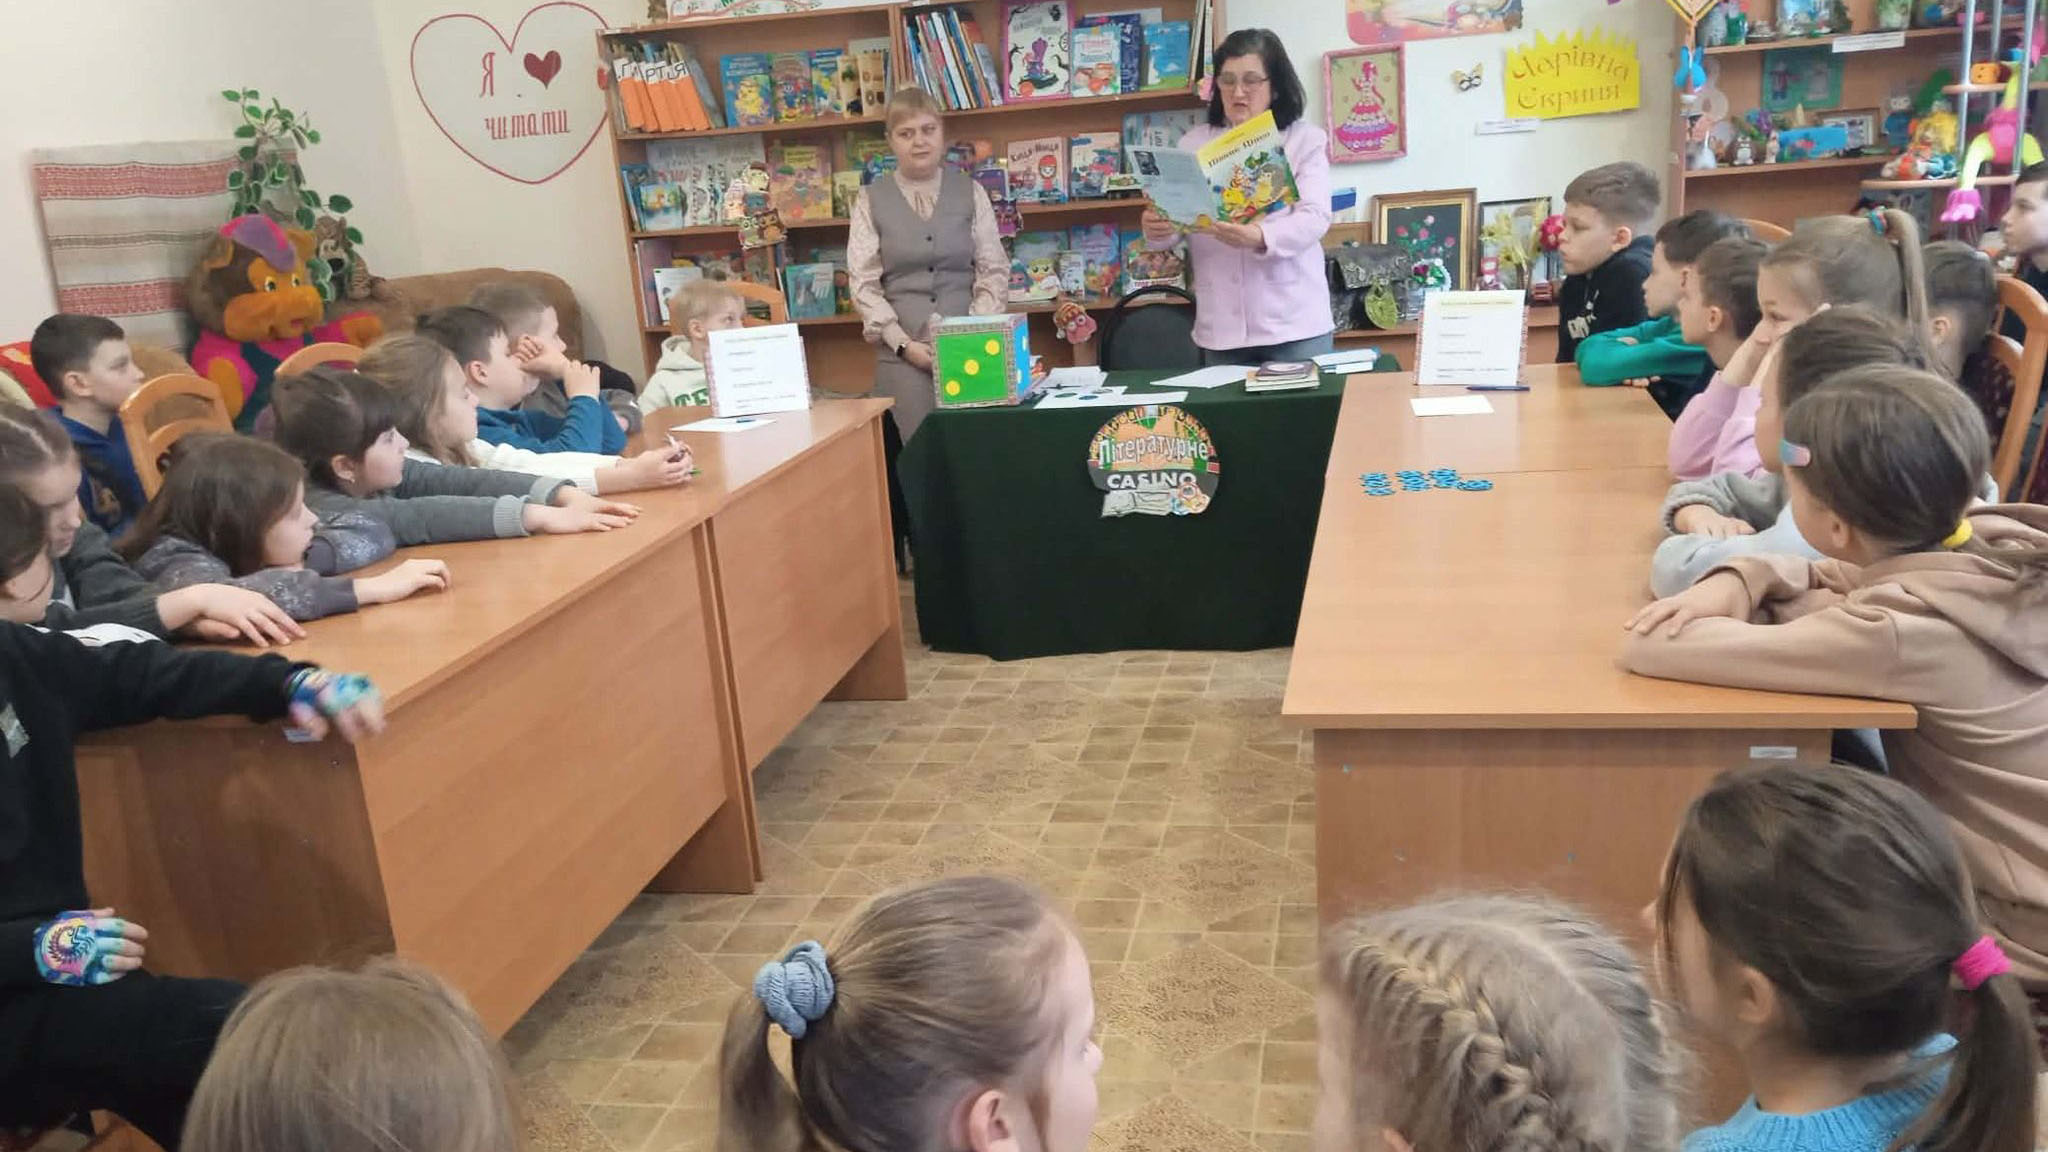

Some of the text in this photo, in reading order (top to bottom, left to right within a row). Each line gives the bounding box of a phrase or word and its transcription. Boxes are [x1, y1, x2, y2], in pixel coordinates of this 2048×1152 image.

[480, 52, 496, 97] Я
[1512, 45, 1630, 82] Чарівна
[484, 109, 571, 140] читати
[1098, 434, 1209, 470] Літературне
[1107, 472, 1197, 489] CASINO
